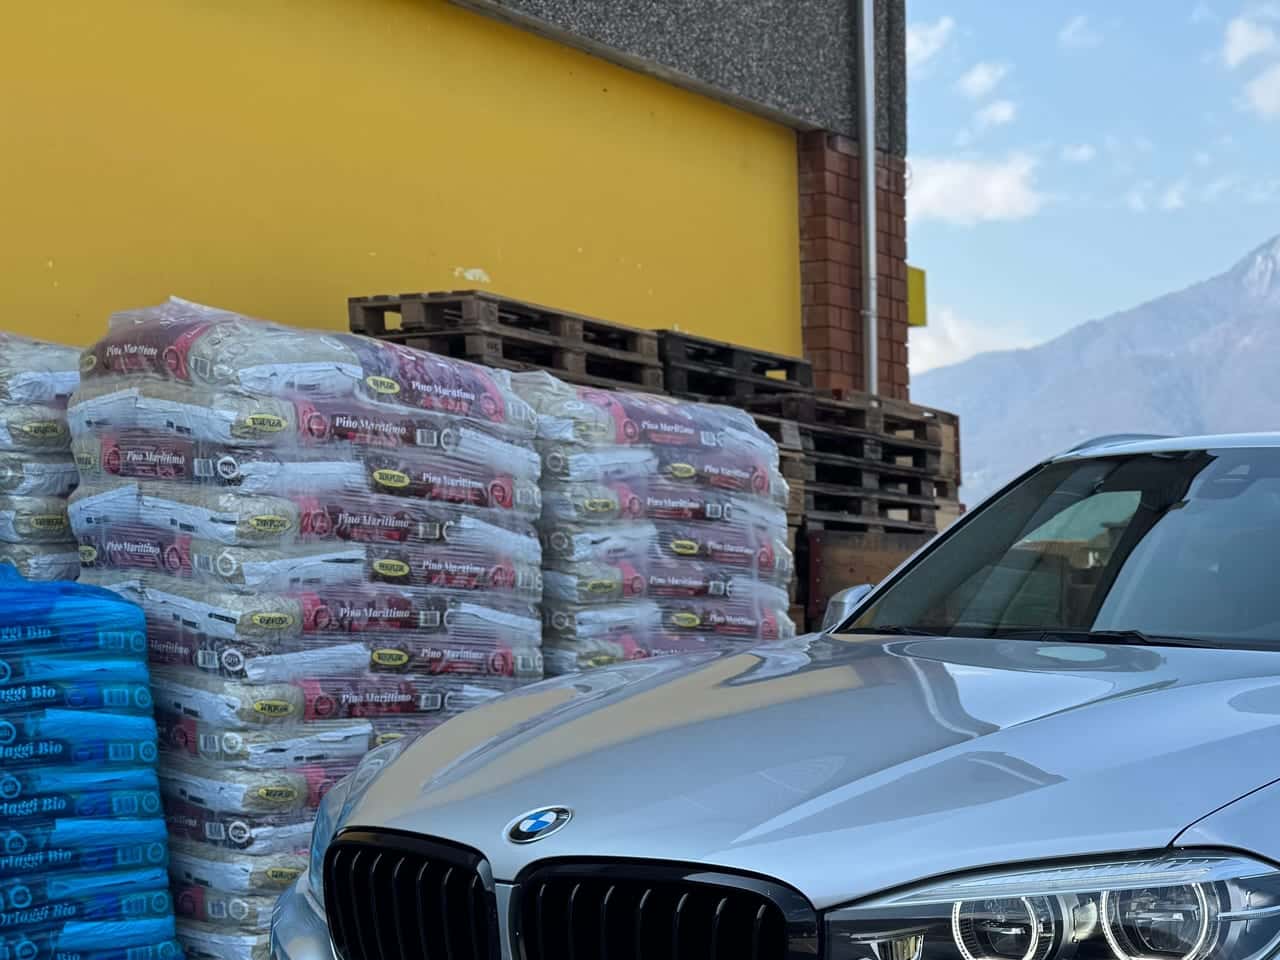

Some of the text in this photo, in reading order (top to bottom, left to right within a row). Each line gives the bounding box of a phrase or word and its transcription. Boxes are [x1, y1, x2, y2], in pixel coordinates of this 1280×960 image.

[335, 415, 358, 429] Pino
[338, 512, 360, 527] Pino
[340, 607, 361, 618] Pino
[32, 685, 56, 698] Bio
[342, 693, 363, 704] Pino
[39, 741, 63, 755] Bio
[42, 797, 66, 811] Bio
[48, 849, 72, 863] Bio
[53, 903, 77, 917] Bio
